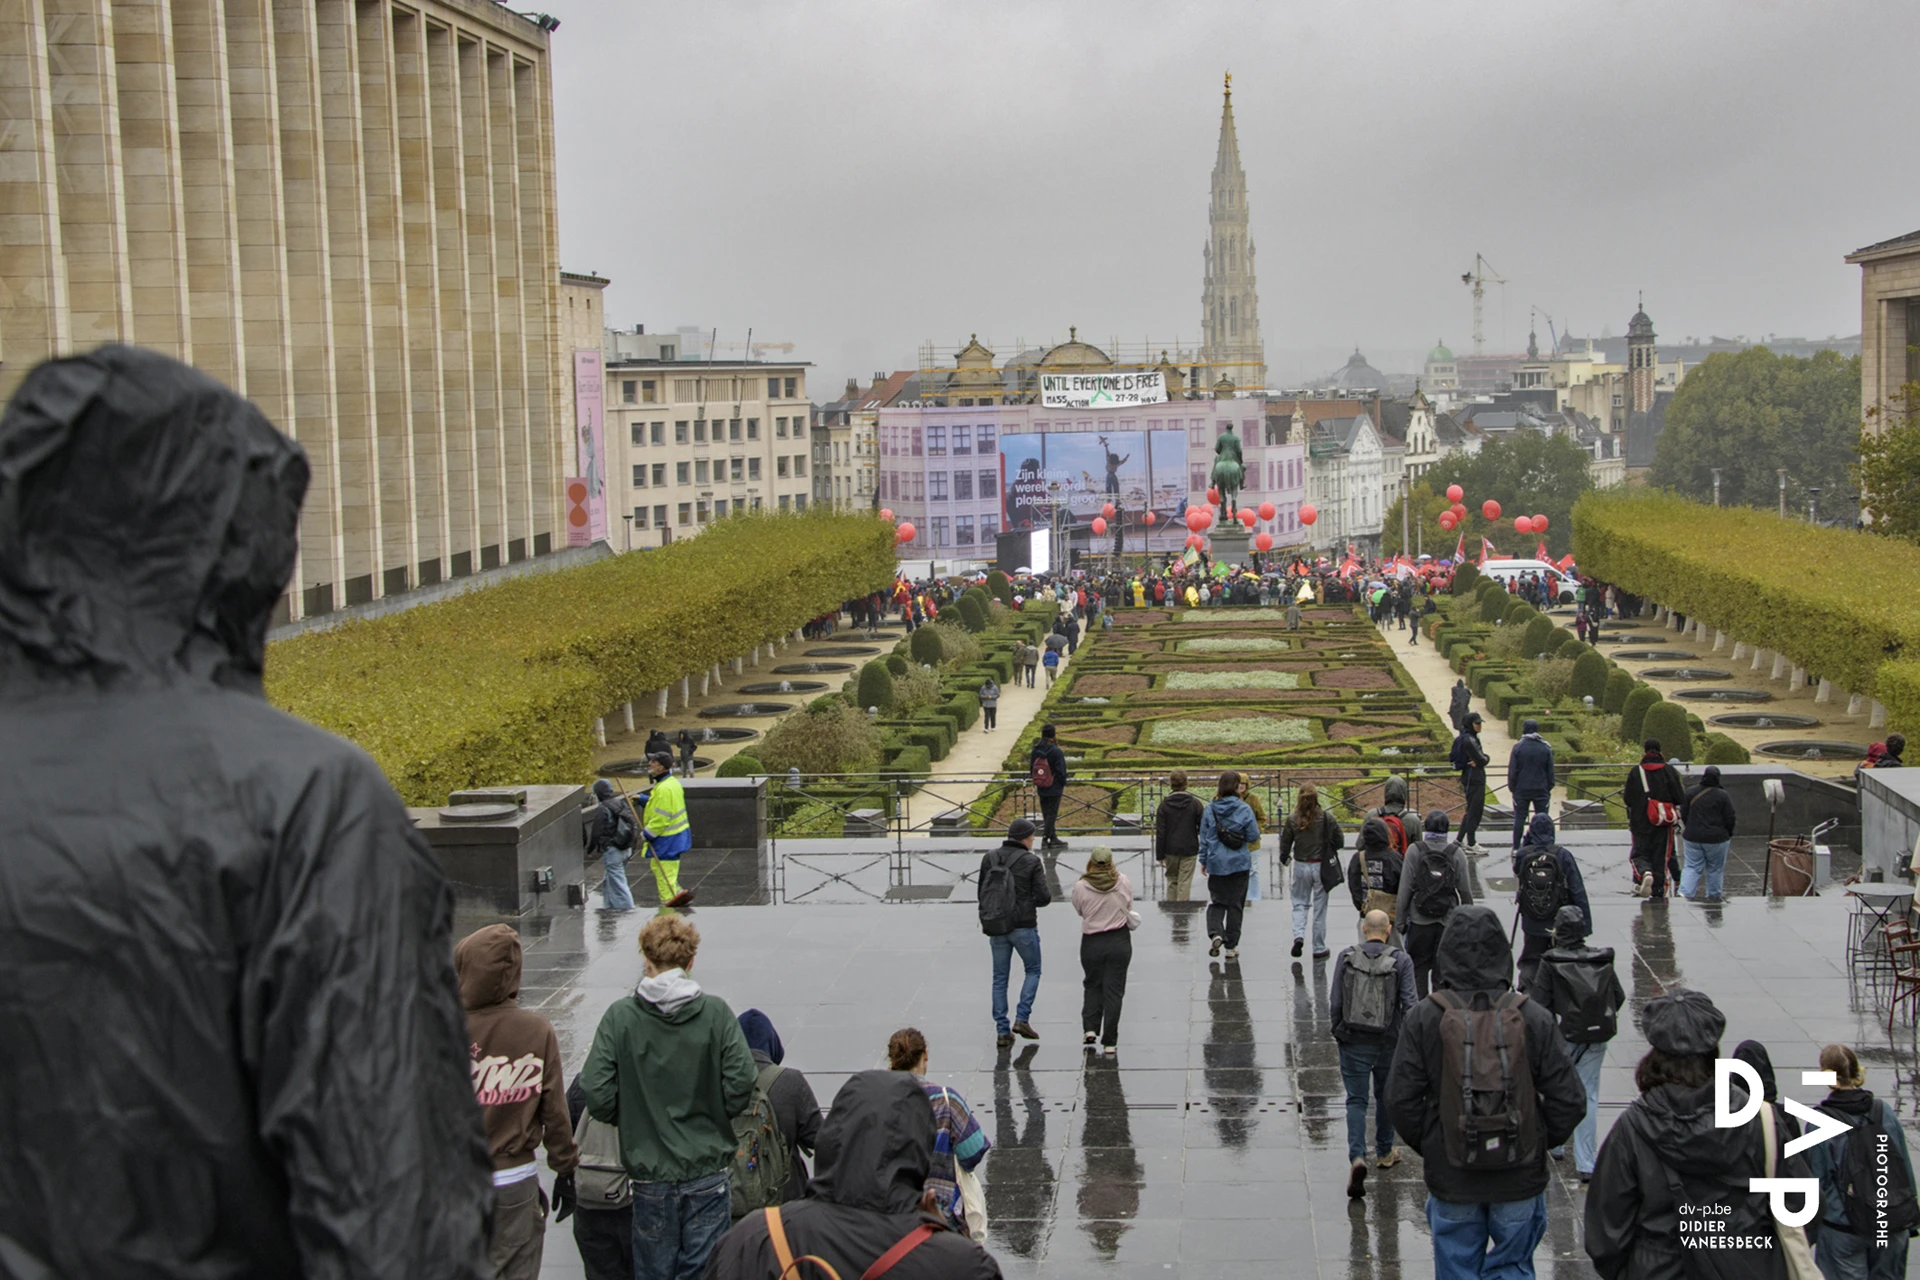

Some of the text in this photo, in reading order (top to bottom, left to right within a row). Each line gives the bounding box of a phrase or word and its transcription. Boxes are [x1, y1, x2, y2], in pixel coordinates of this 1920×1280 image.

[1043, 373, 1160, 391] UNTIL EVERYONE IS FREE
[1046, 395, 1090, 407] MASS ACTION
[1115, 394, 1157, 404] 27-28 NOV
[1015, 468, 1069, 482] Zijn kleine
